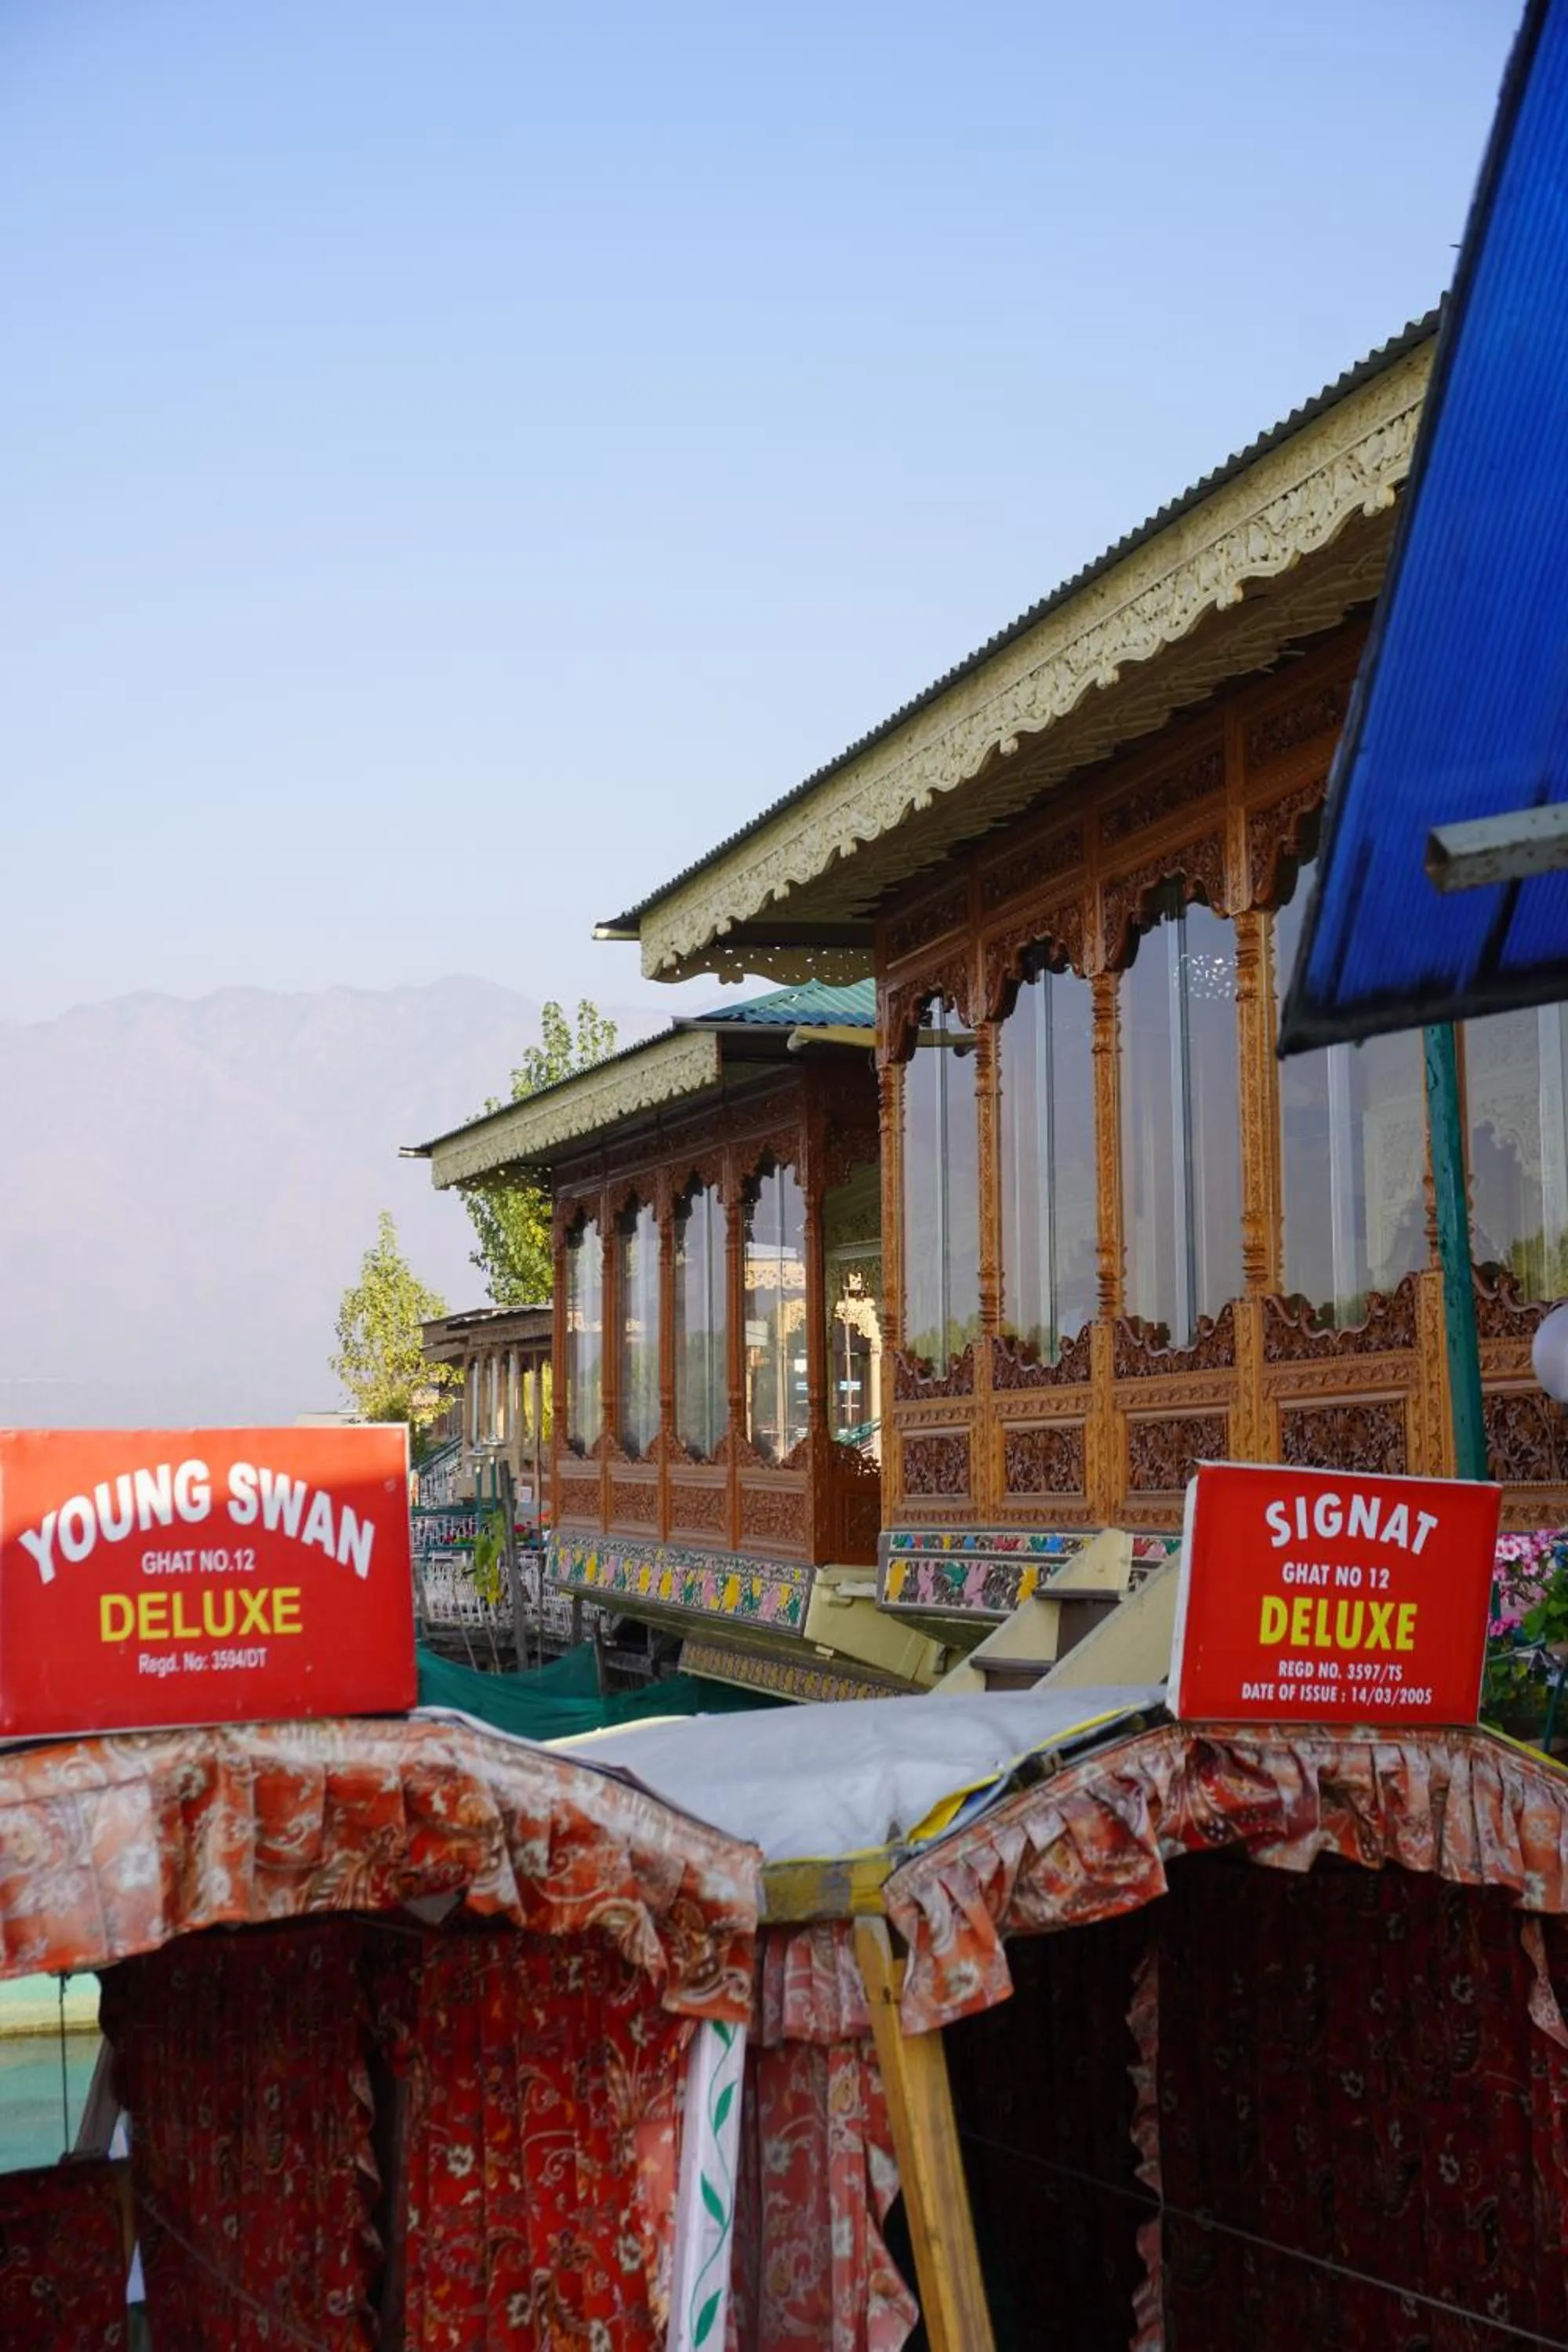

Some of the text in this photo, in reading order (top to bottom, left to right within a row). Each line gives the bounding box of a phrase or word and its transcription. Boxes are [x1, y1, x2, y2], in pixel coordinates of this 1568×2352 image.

[19, 1459, 375, 1584] YOUNG SWAN
[1265, 1492, 1439, 1555] SIGNAT
[141, 1551, 194, 1574] GHAT
[1282, 1561, 1390, 1589] GHAT NO 12
[100, 1587, 303, 1642] DELUXE
[1258, 1595, 1418, 1651] DELUXE
[139, 1652, 180, 1678] Regd.
[1279, 1660, 1403, 1684] REGD NO. 3597/TS
[1241, 1682, 1275, 1700] DATE
[1278, 1684, 1298, 1700] OF
[1299, 1685, 1338, 1703] ISSUE
[1351, 1687, 1432, 1707] 14/03/2005
